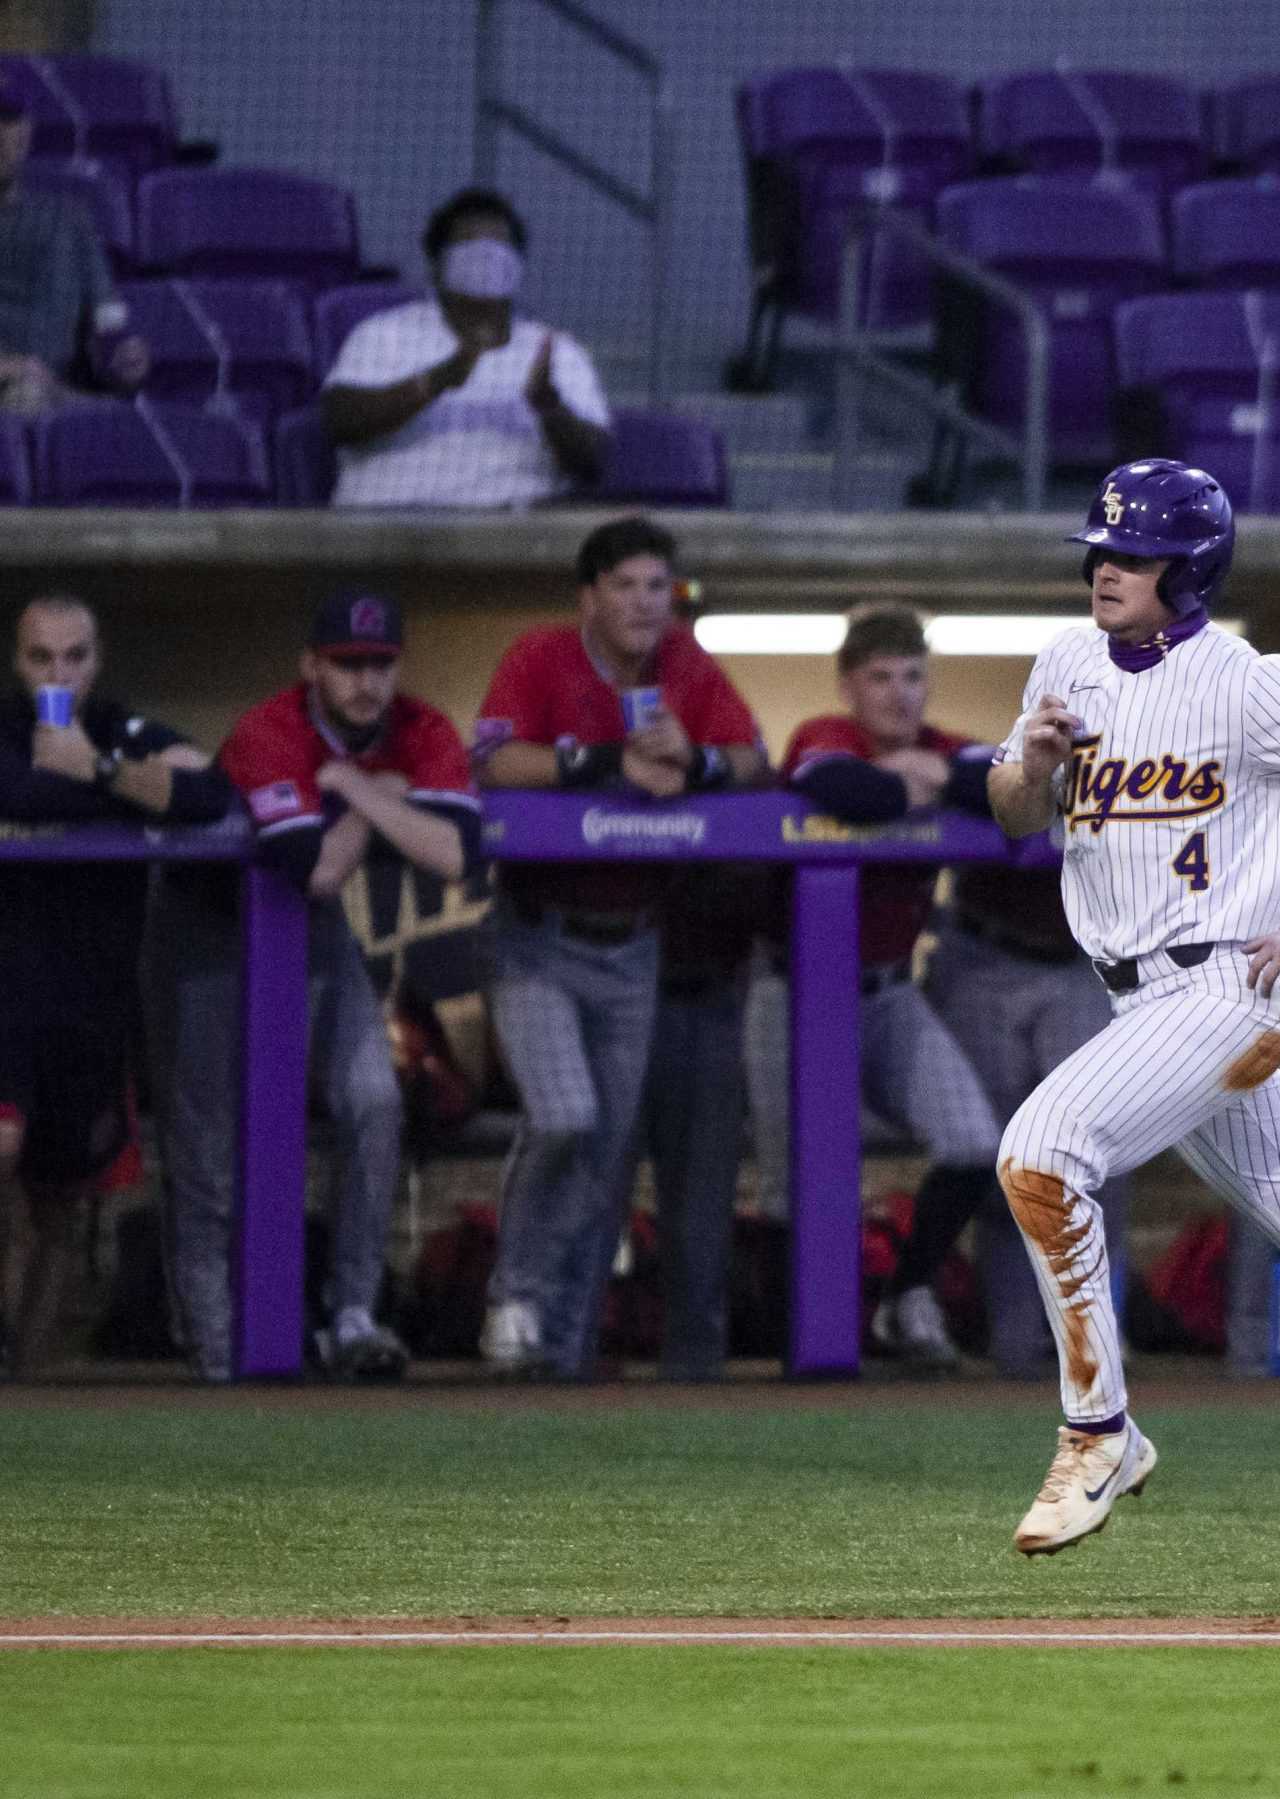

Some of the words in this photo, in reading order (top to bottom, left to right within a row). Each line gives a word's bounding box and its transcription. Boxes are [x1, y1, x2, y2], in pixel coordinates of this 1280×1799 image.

[1102, 481, 1125, 526] LSU
[1059, 732, 1226, 835] Tigers
[1171, 831, 1210, 893] 4
